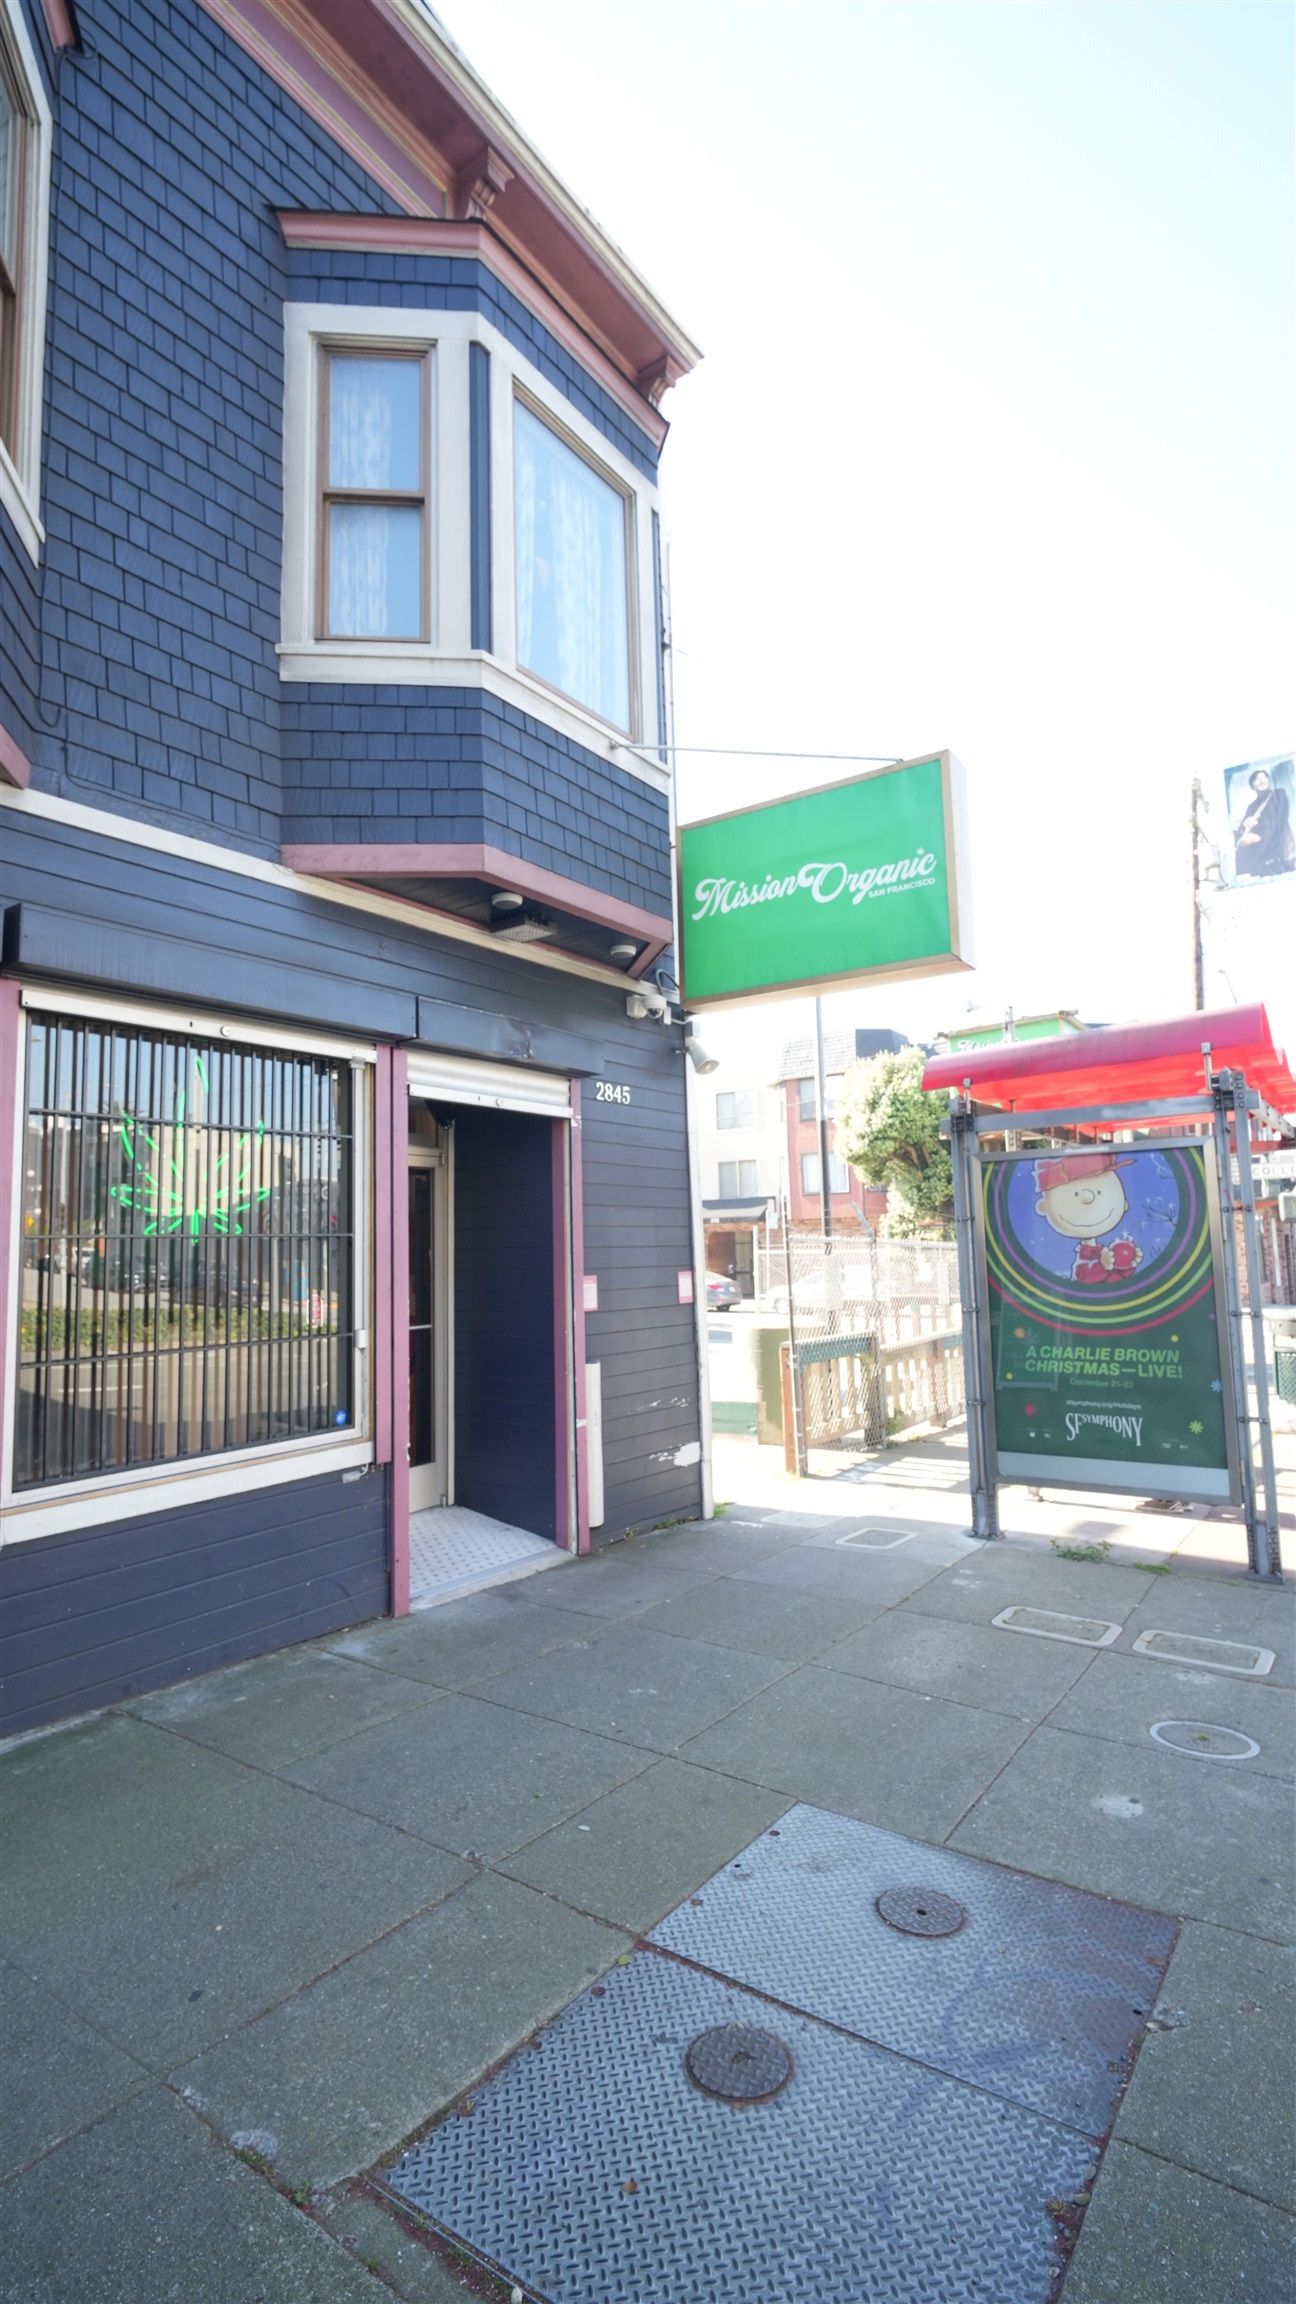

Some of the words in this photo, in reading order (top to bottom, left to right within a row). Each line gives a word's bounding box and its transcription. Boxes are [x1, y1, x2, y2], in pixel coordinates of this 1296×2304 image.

[692, 874, 798, 921] Mission
[797, 847, 937, 905] Organic
[868, 888, 885, 898] SAN
[887, 877, 936, 894] FRANCISCO
[595, 1081, 631, 1105] 2845
[1025, 1345, 1037, 1358] A
[1040, 1345, 1111, 1361] CHARLIE
[1114, 1348, 1180, 1363] BROWN
[1069, 1378, 1109, 1387] December
